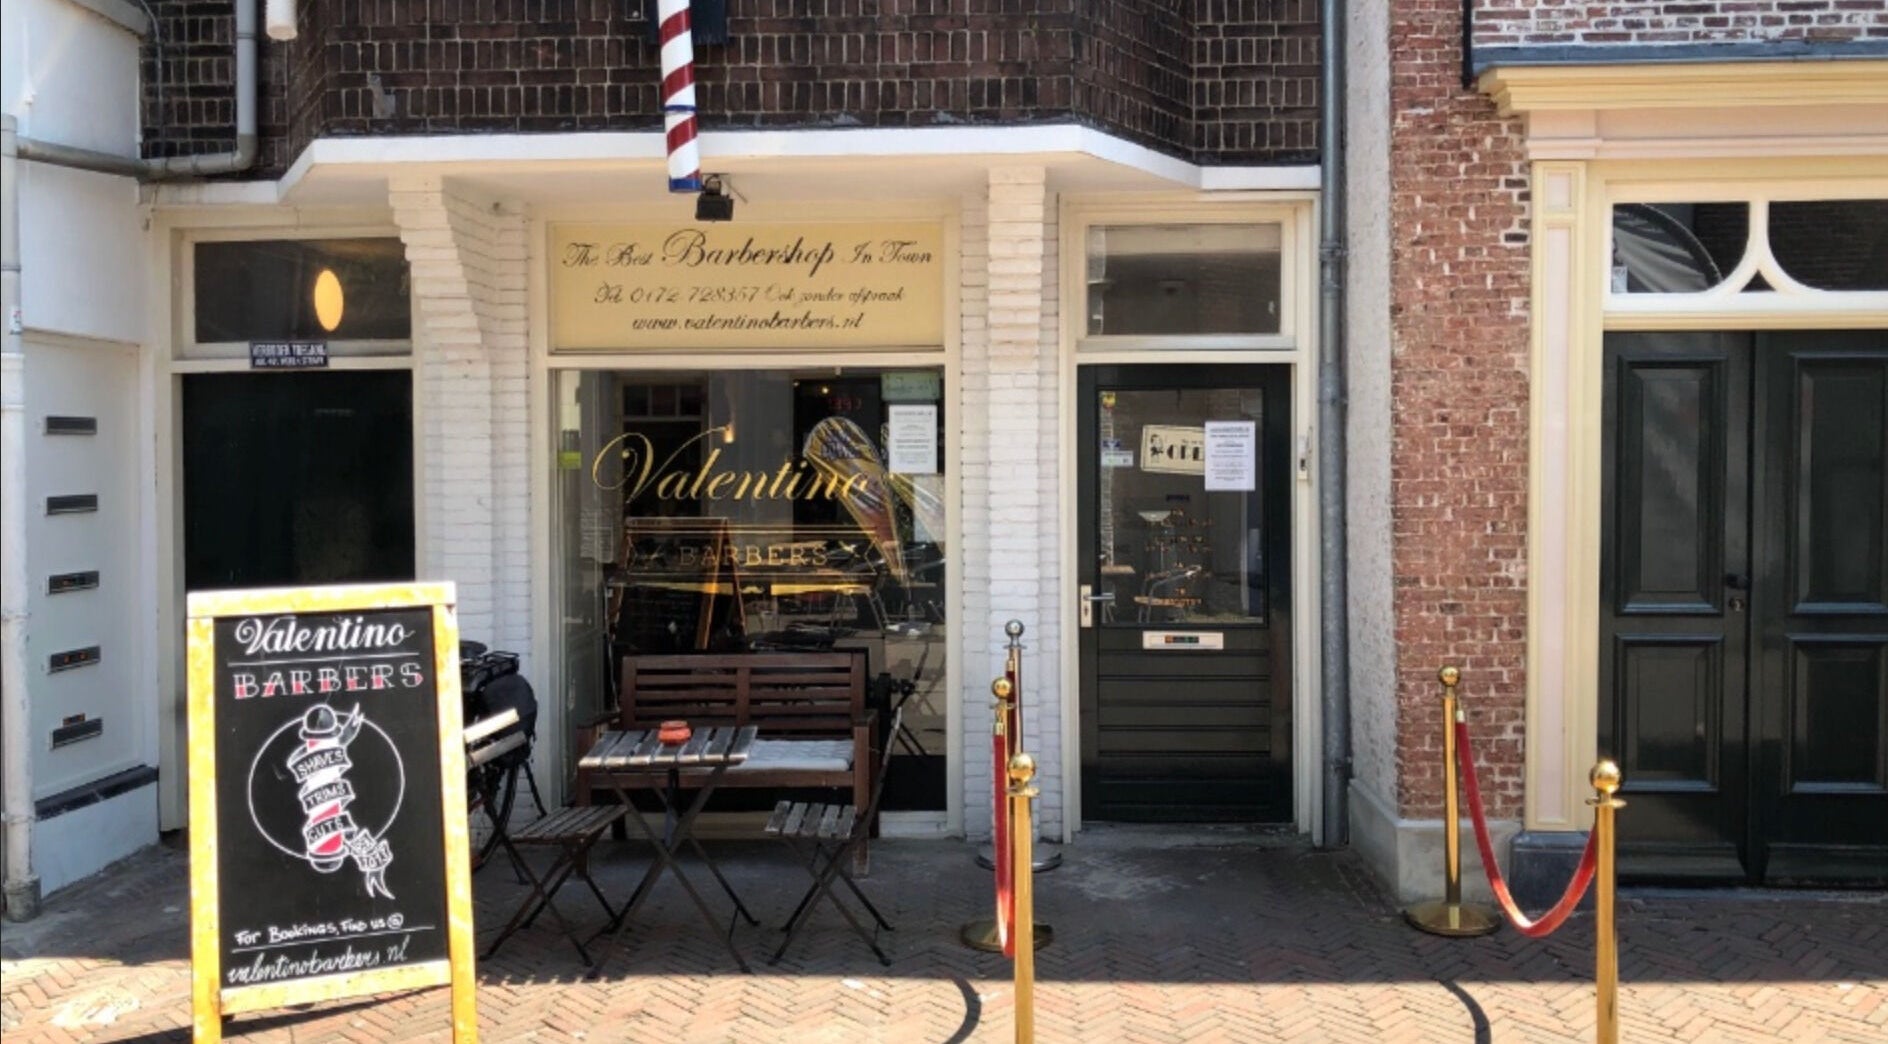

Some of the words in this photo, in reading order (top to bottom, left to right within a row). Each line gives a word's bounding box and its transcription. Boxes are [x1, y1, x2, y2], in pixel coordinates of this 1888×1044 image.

[562, 242, 599, 268] The
[605, 242, 653, 267] Best
[661, 229, 834, 278] Barbershop
[849, 241, 872, 263] In
[879, 240, 932, 264] Town
[630, 286, 679, 304] 0172
[687, 286, 761, 304] 728357
[795, 286, 844, 307] zonder
[848, 286, 904, 305] afspraak
[632, 310, 864, 331] www.valentinobarbers.nl
[592, 426, 868, 503] Valentino
[679, 545, 829, 567] BARBERS
[234, 616, 416, 656] Valentino
[233, 662, 424, 700] BARBERS
[297, 750, 344, 777] SHAVES
[306, 783, 346, 805] TRIMS
[308, 816, 344, 843] CUTS
[387, 912, 404, 930] @
